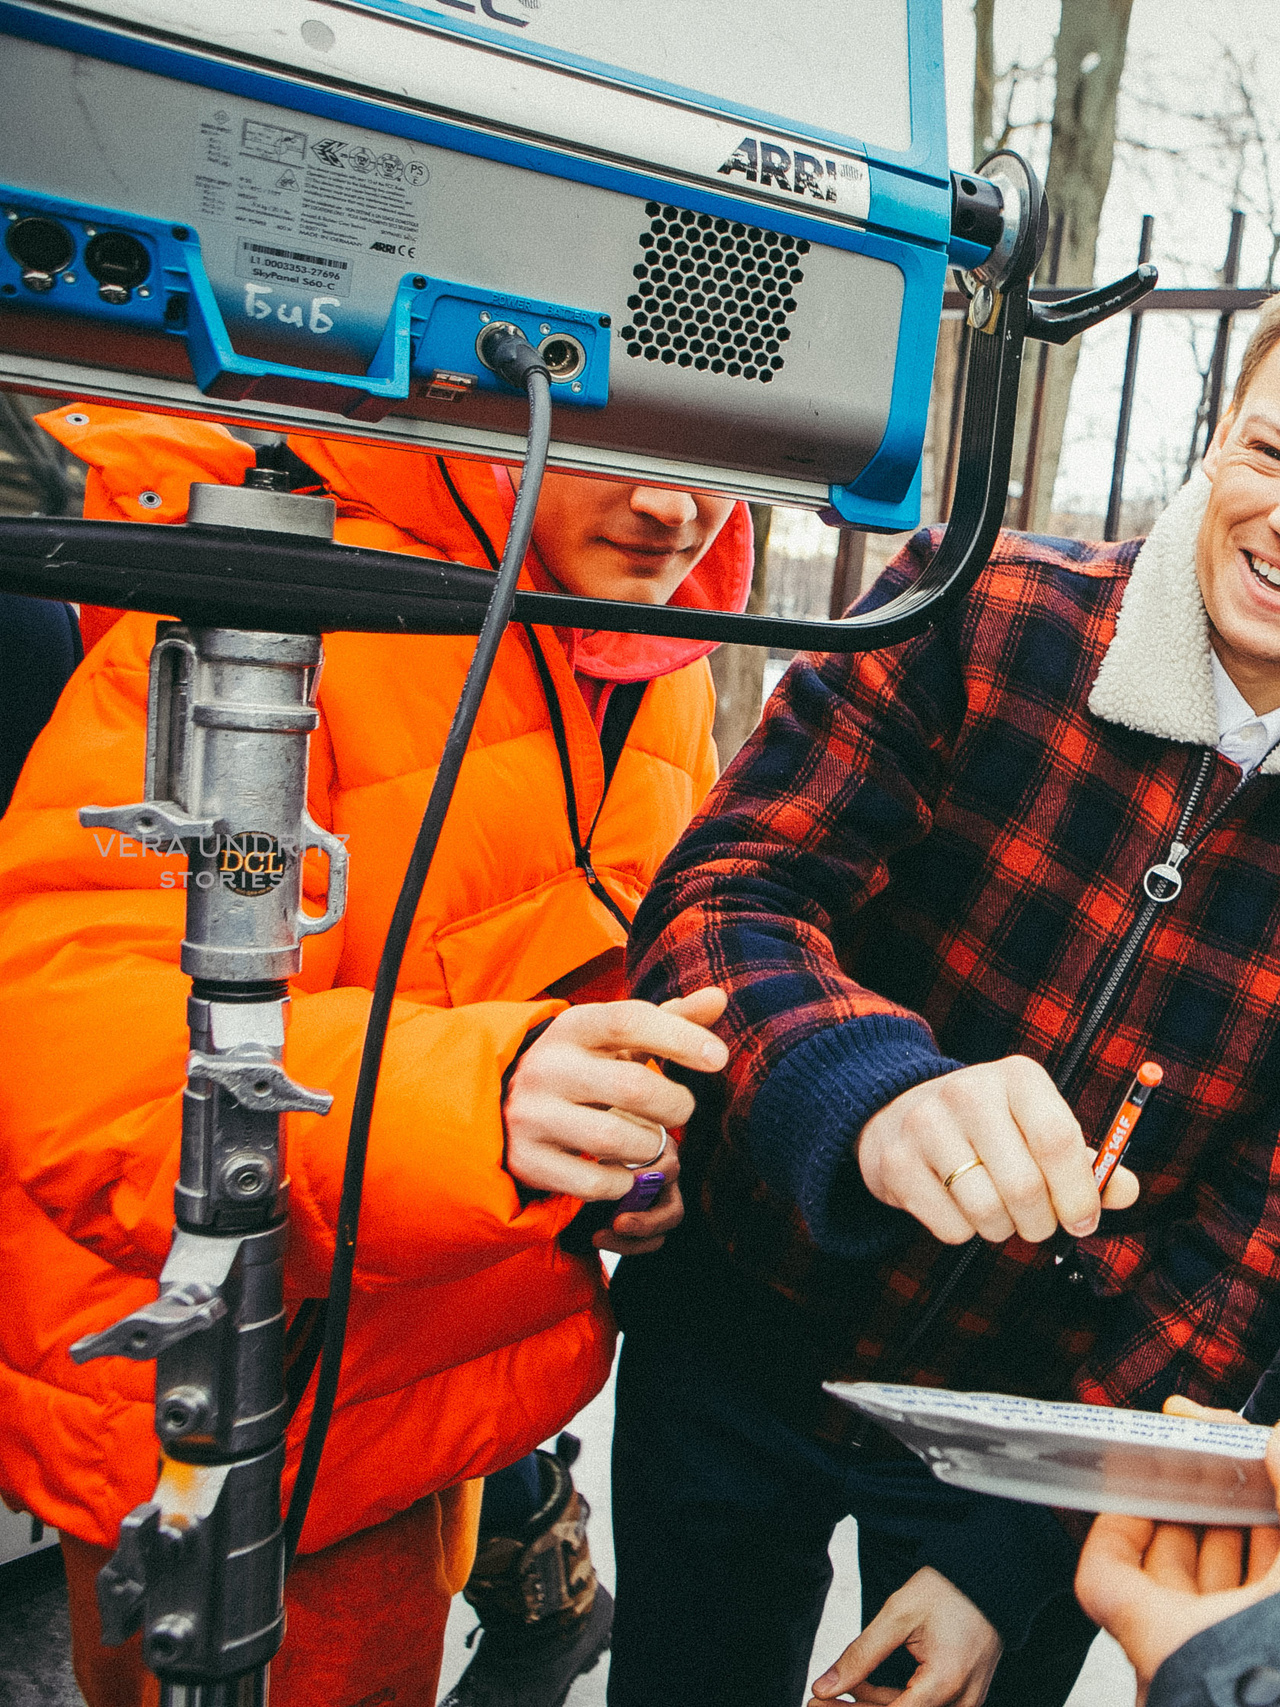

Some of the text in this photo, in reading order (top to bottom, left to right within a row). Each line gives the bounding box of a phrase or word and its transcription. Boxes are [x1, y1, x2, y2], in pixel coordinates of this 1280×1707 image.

[717, 137, 837, 203] ARRI
[369, 241, 396, 255] ARRI
[252, 267, 336, 291] SkyPanel S60-C
[492, 294, 532, 312] POWER
[219, 849, 284, 874] DCL
[1094, 1151, 1117, 1188] ding
[1109, 1126, 1127, 1150] 141
